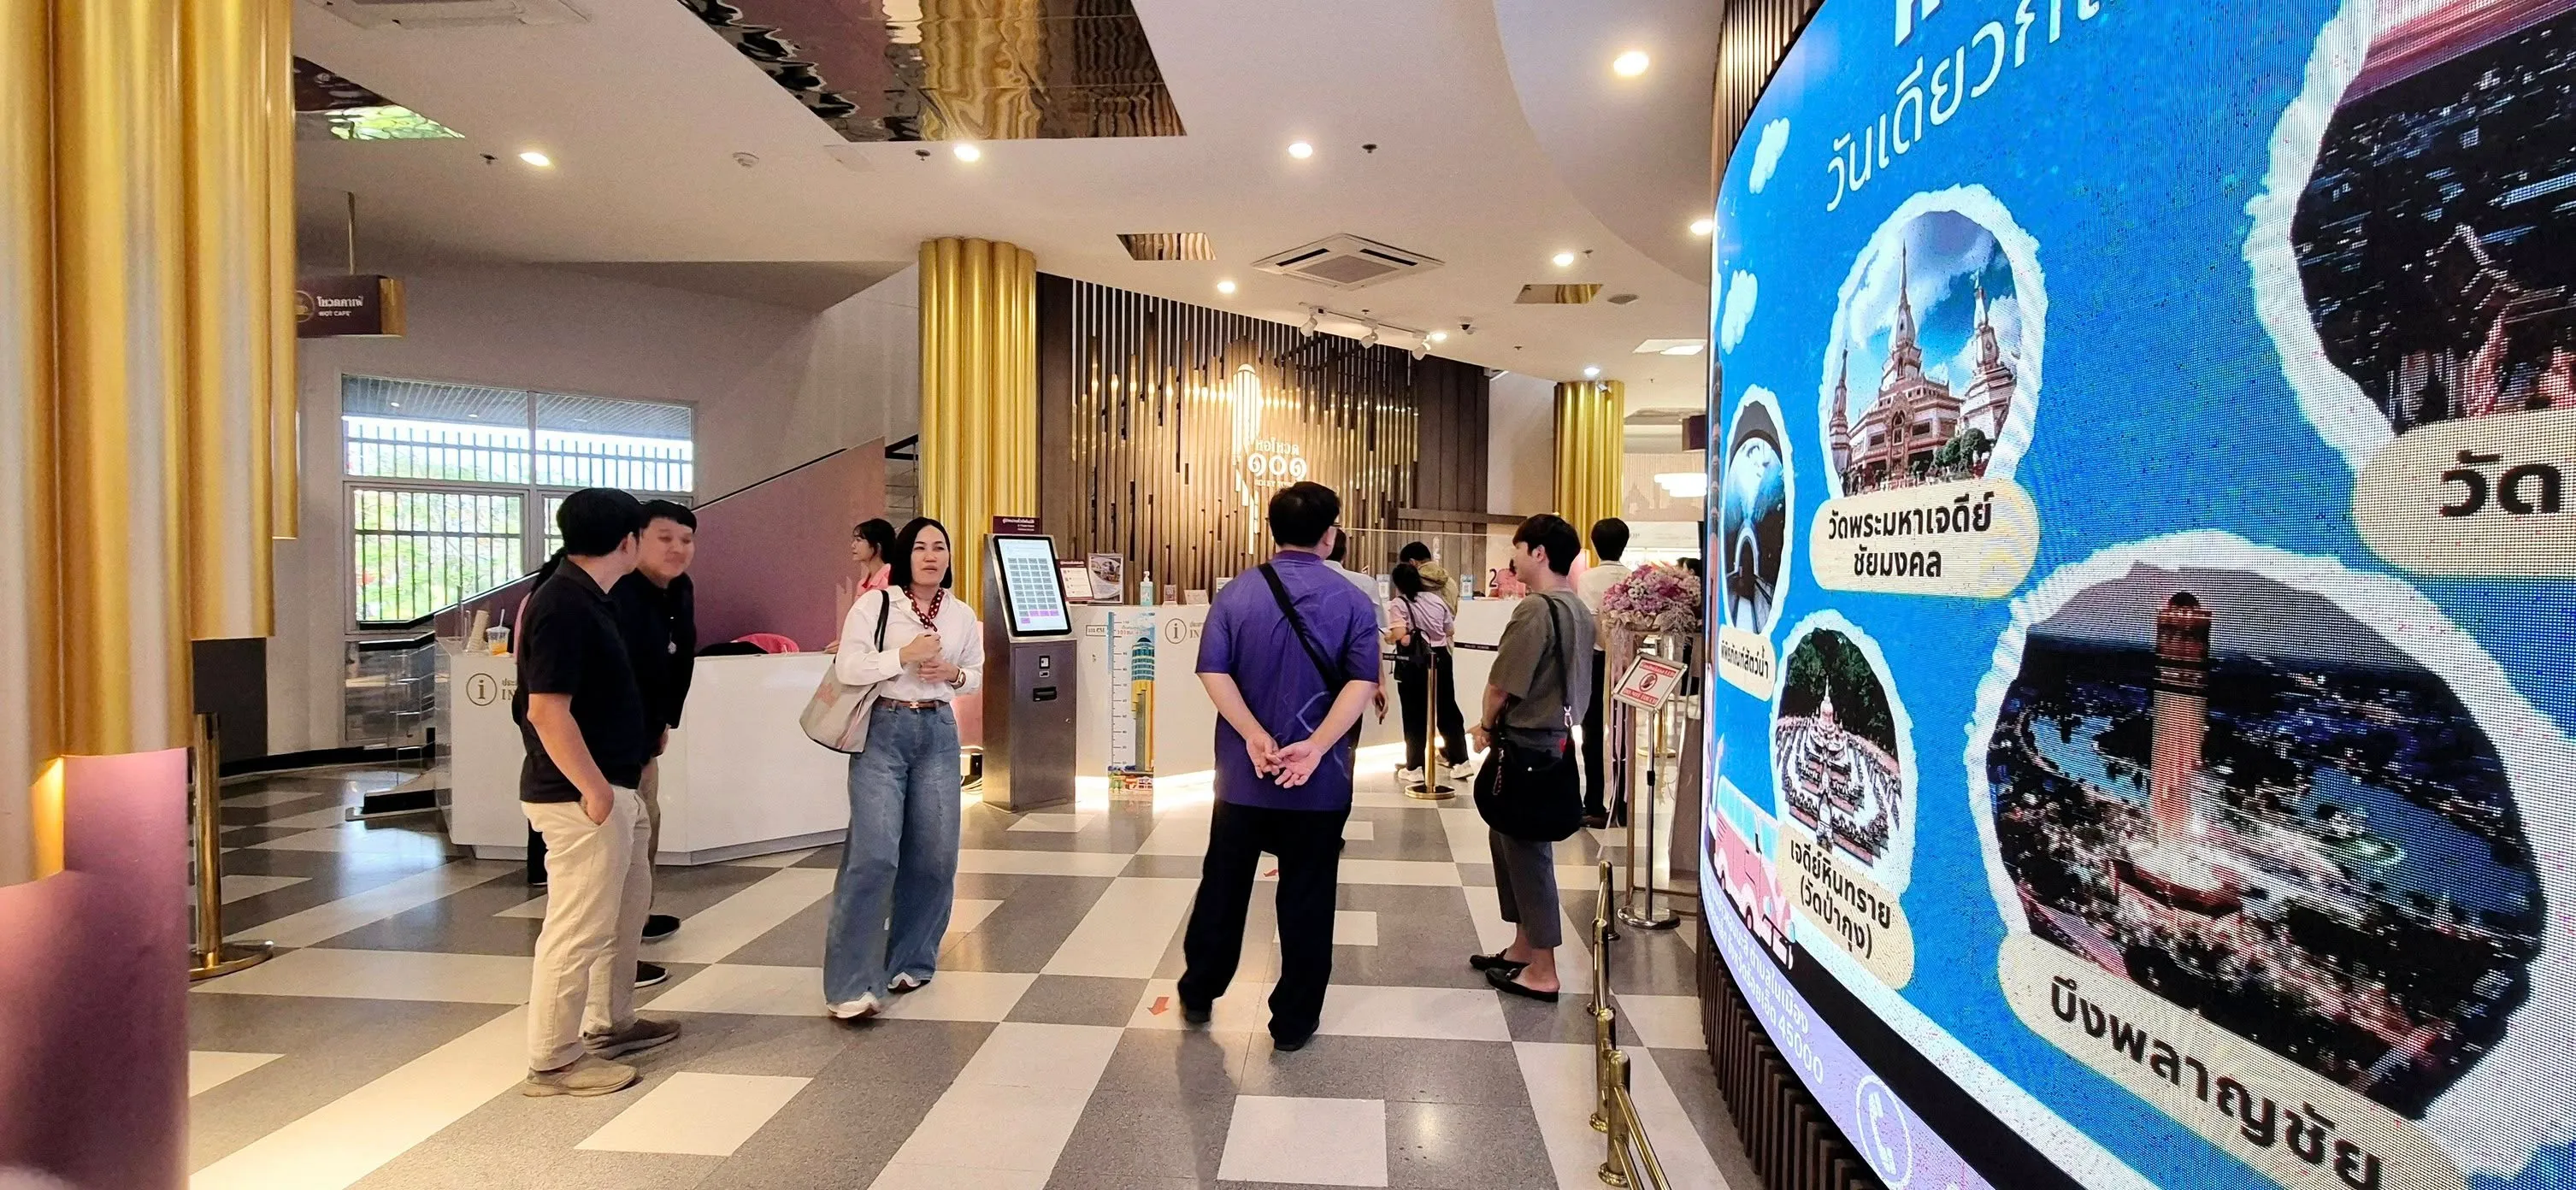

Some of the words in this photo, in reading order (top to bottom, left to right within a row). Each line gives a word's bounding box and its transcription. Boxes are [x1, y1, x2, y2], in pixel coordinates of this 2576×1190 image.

[1828, 491, 1995, 539] วัดพระมหาเจดีย์
[2439, 450, 2561, 518] วัด
[1854, 544, 1942, 578] ชัยมงคล
[1790, 839, 1891, 929] เจดีย์หินทราย
[1801, 875, 1872, 959] (วัดป่ากุง)
[1778, 1014, 1824, 1085] 45000
[2050, 975, 2381, 1190] บึงพลาญชัย
